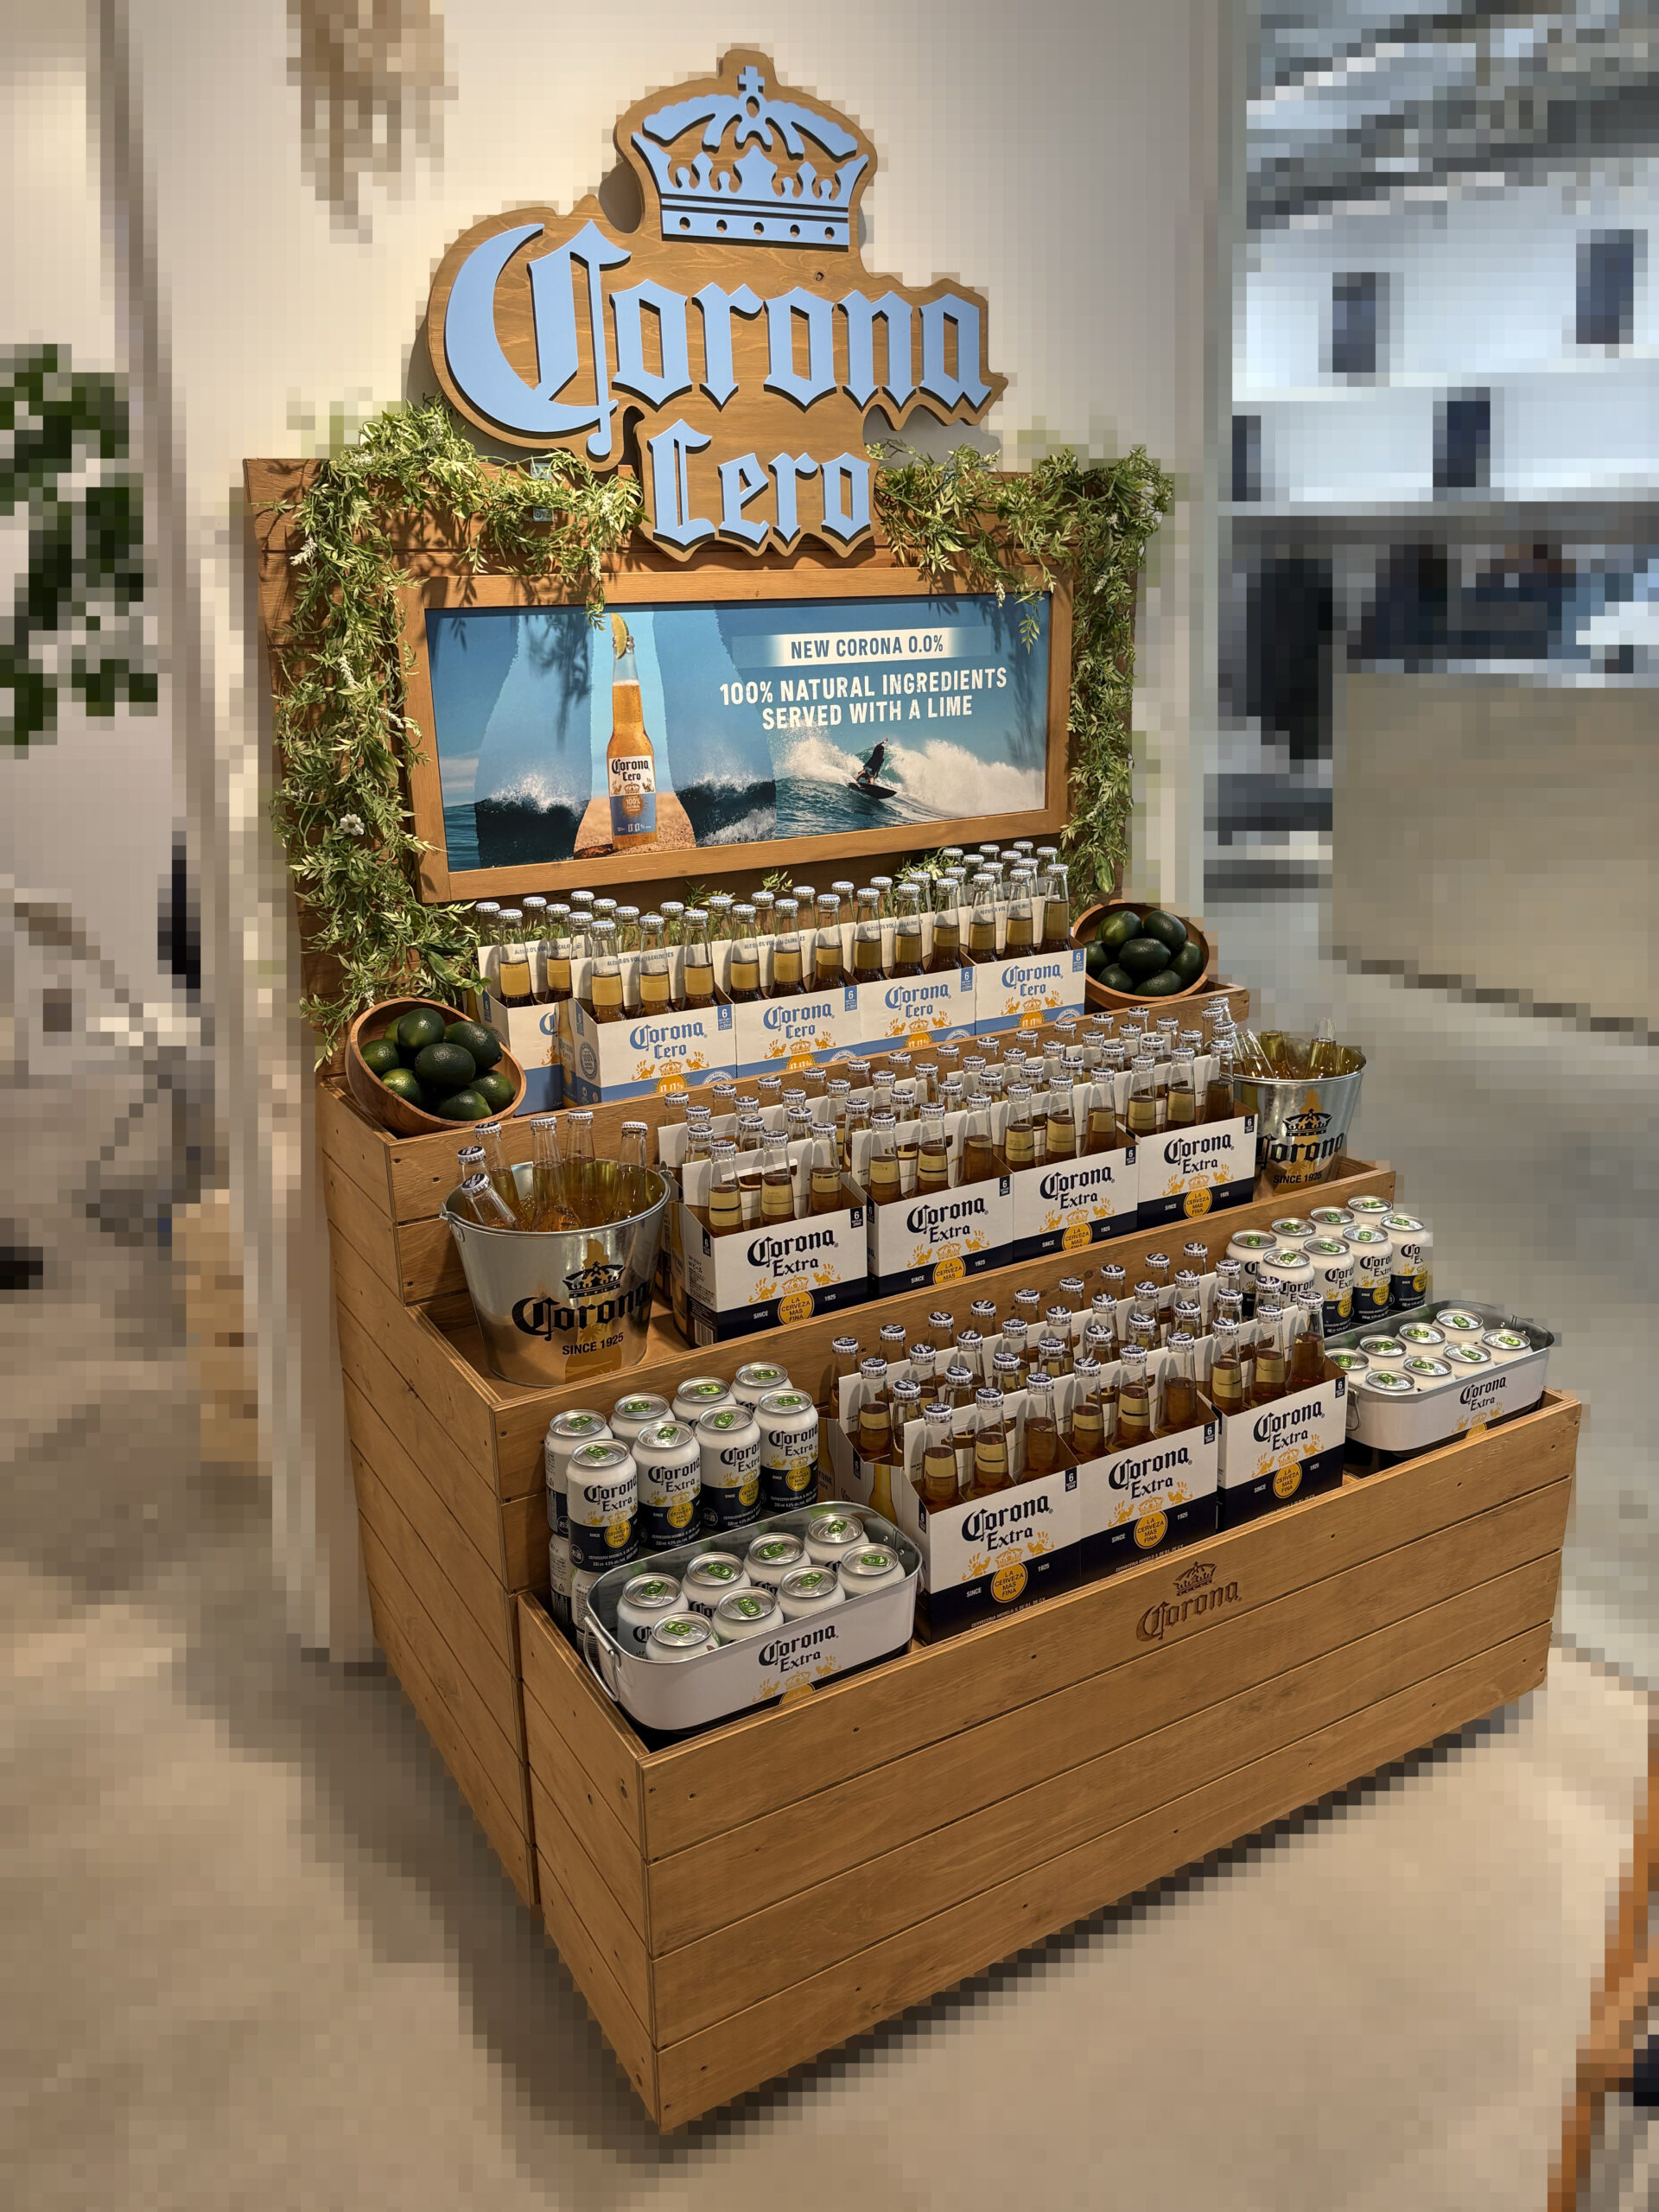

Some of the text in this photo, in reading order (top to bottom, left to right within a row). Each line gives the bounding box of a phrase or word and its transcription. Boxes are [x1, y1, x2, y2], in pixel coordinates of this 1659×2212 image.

[444, 219, 992, 456] Corona
[647, 418, 871, 546] Cero
[791, 634, 944, 659] NEW CORONA 0.0%
[719, 666, 1007, 706] 100% NATURAL INGREDIENTS
[762, 695, 973, 731] SERVED WITH A LIME
[611, 759, 650, 775] Corona
[622, 772, 641, 781] Cero
[1076, 952, 1081, 961] 6
[964, 971, 969, 981] 6
[1001, 964, 1061, 989] Corona
[849, 990, 854, 1000] 6
[885, 984, 949, 1011] Corona
[1020, 983, 1046, 997] Cero
[721, 1008, 728, 1019] 6
[763, 1003, 832, 1031] Corona
[906, 1004, 933, 1018] Cero
[629, 1022, 704, 1052] Corona
[785, 1024, 816, 1039] Cero
[654, 1044, 687, 1059] Cero
[1247, 1118, 1252, 1127] 6
[1128, 1148, 1133, 1158] 6
[1164, 1134, 1232, 1166] Corona
[1182, 1158, 1218, 1175] Extra
[1002, 1179, 1007, 1188] 6
[1039, 1166, 1112, 1200] Corona
[1273, 1170, 1323, 1184] SINCE 1925
[1059, 1192, 1098, 1210] Extra
[1186, 1196, 1210, 1206] CERVEZA
[854, 1211, 860, 1220] 6
[906, 1197, 985, 1235] Corona
[929, 1224, 970, 1244] Extra
[1065, 1231, 1089, 1242] CERVEZA
[747, 1229, 836, 1268] Corona
[772, 1257, 819, 1278] Extra
[936, 1265, 963, 1277] CERVEZA
[781, 1300, 810, 1312] CERVEZA
[562, 1332, 624, 1356] SINCE 1925
[1338, 1380, 1343, 1390] 6
[1459, 1376, 1507, 1405] Corona
[1470, 1396, 1495, 1411] Extra
[1253, 1401, 1322, 1442] Corona
[1207, 1426, 1212, 1436] 6
[1272, 1428, 1308, 1452] Extra
[785, 1444, 813, 1457] Extra
[1068, 1472, 1074, 1482] 6
[1109, 1447, 1189, 1491] Corona
[665, 1478, 696, 1493] Extra
[1276, 1472, 1299, 1484] CERVEZA
[1130, 1476, 1173, 1499] Extra
[602, 1496, 632, 1512] Extra
[961, 1495, 1050, 1542] Corona
[1137, 1522, 1164, 1534] CERVEZA
[986, 1524, 1033, 1552] Extra
[995, 1573, 1024, 1587] CERVEZA
[1135, 1581, 1239, 1642] Corona
[758, 1624, 836, 1667] Corona
[779, 1650, 821, 1673] Extra
